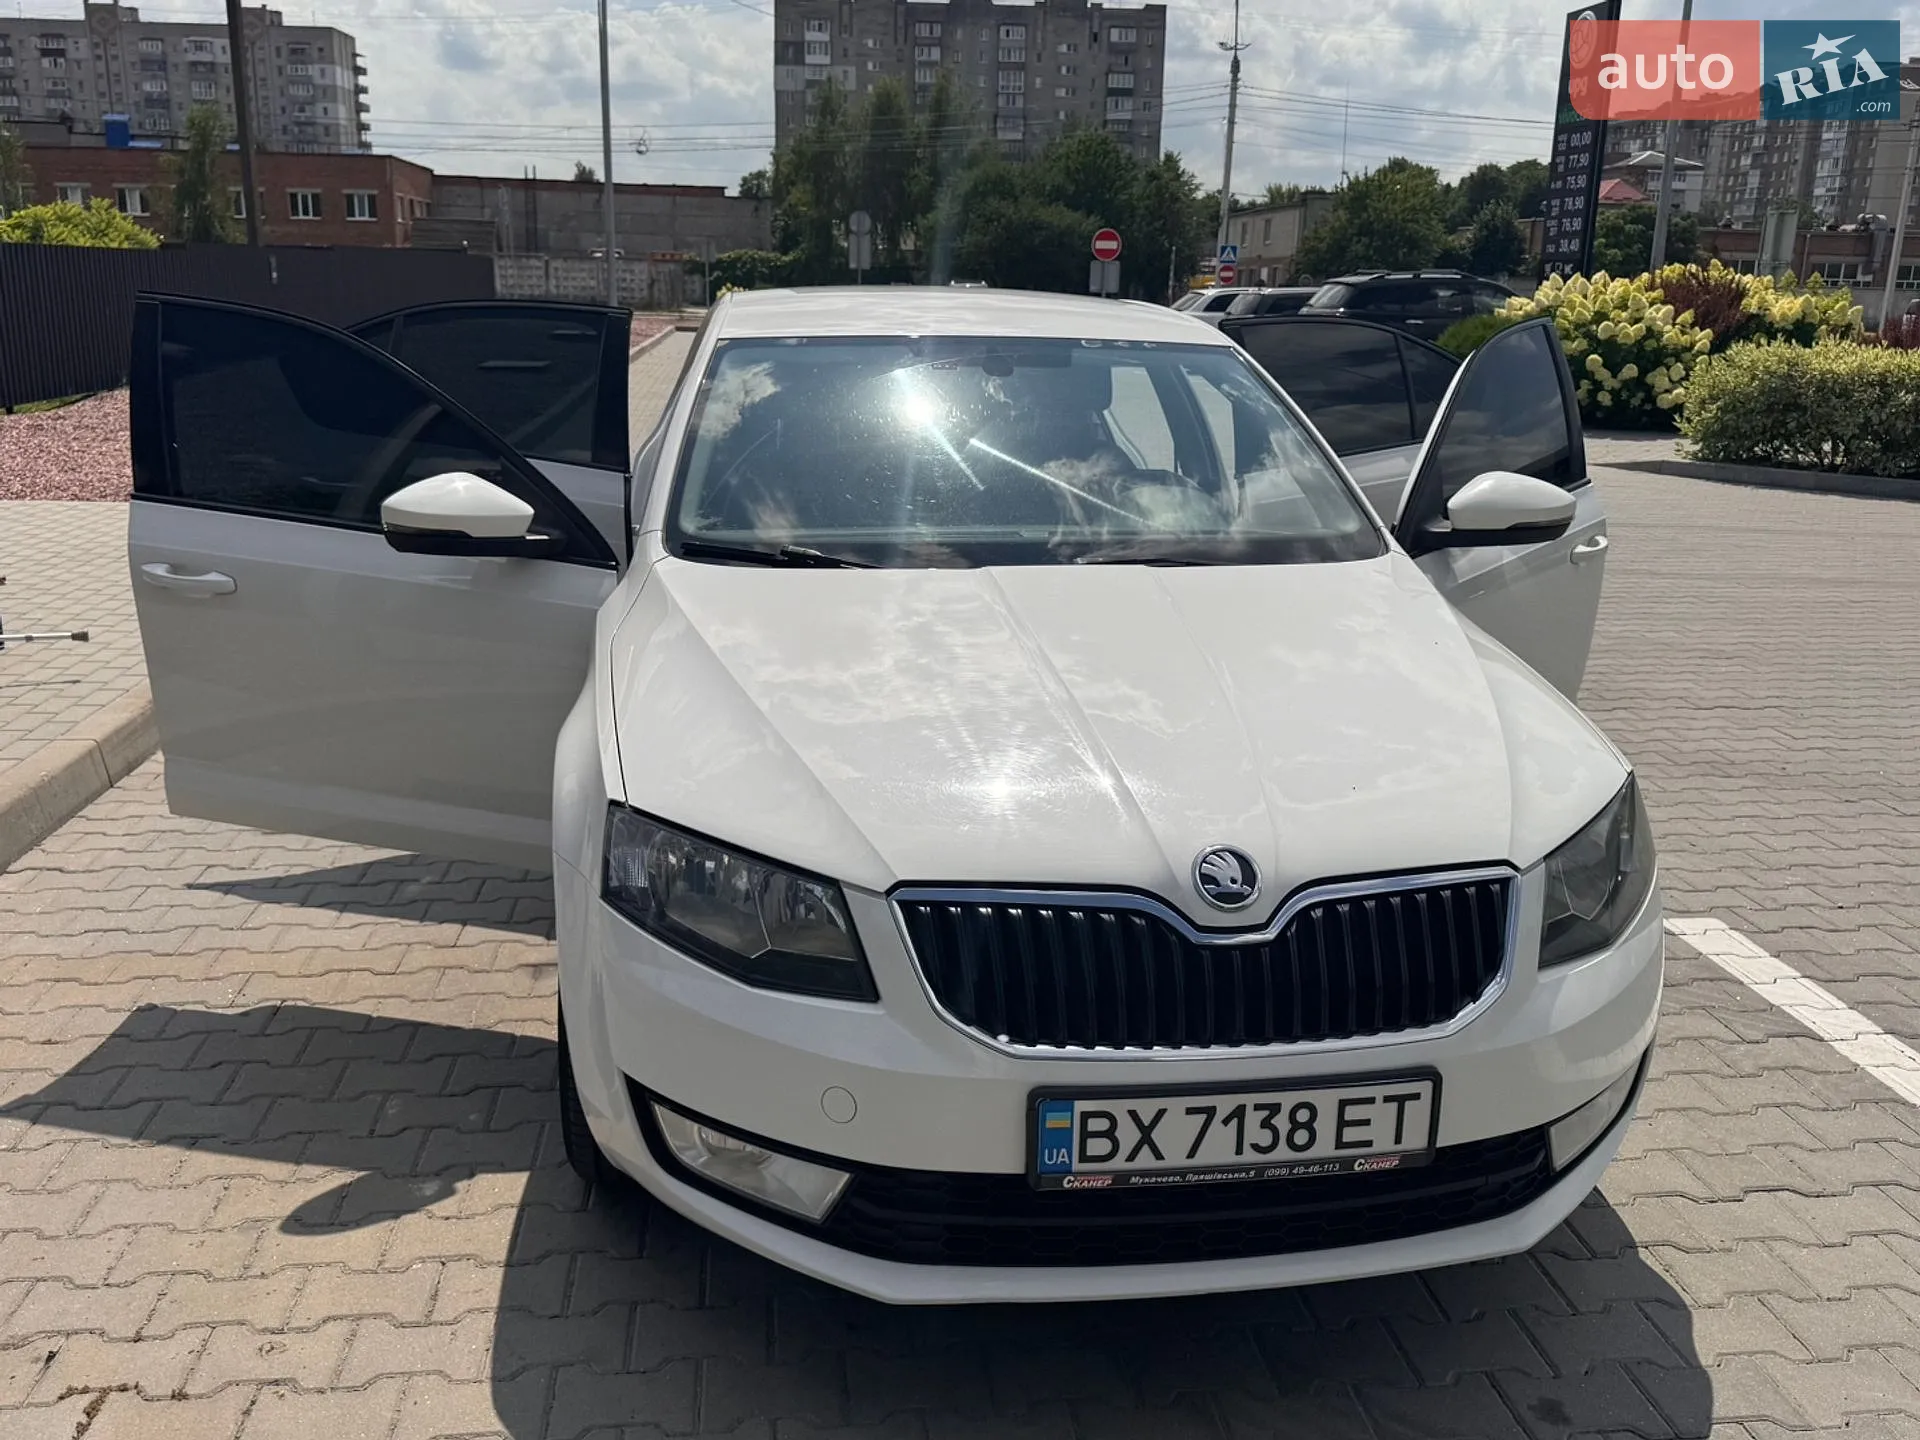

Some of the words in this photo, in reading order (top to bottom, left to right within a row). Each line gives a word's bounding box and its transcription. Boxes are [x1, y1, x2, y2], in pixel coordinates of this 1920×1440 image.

[1078, 1107, 1168, 1164] BX
[1184, 1102, 1319, 1160] 7138
[1334, 1092, 1422, 1151] ET
[1043, 1149, 1070, 1165] UA
